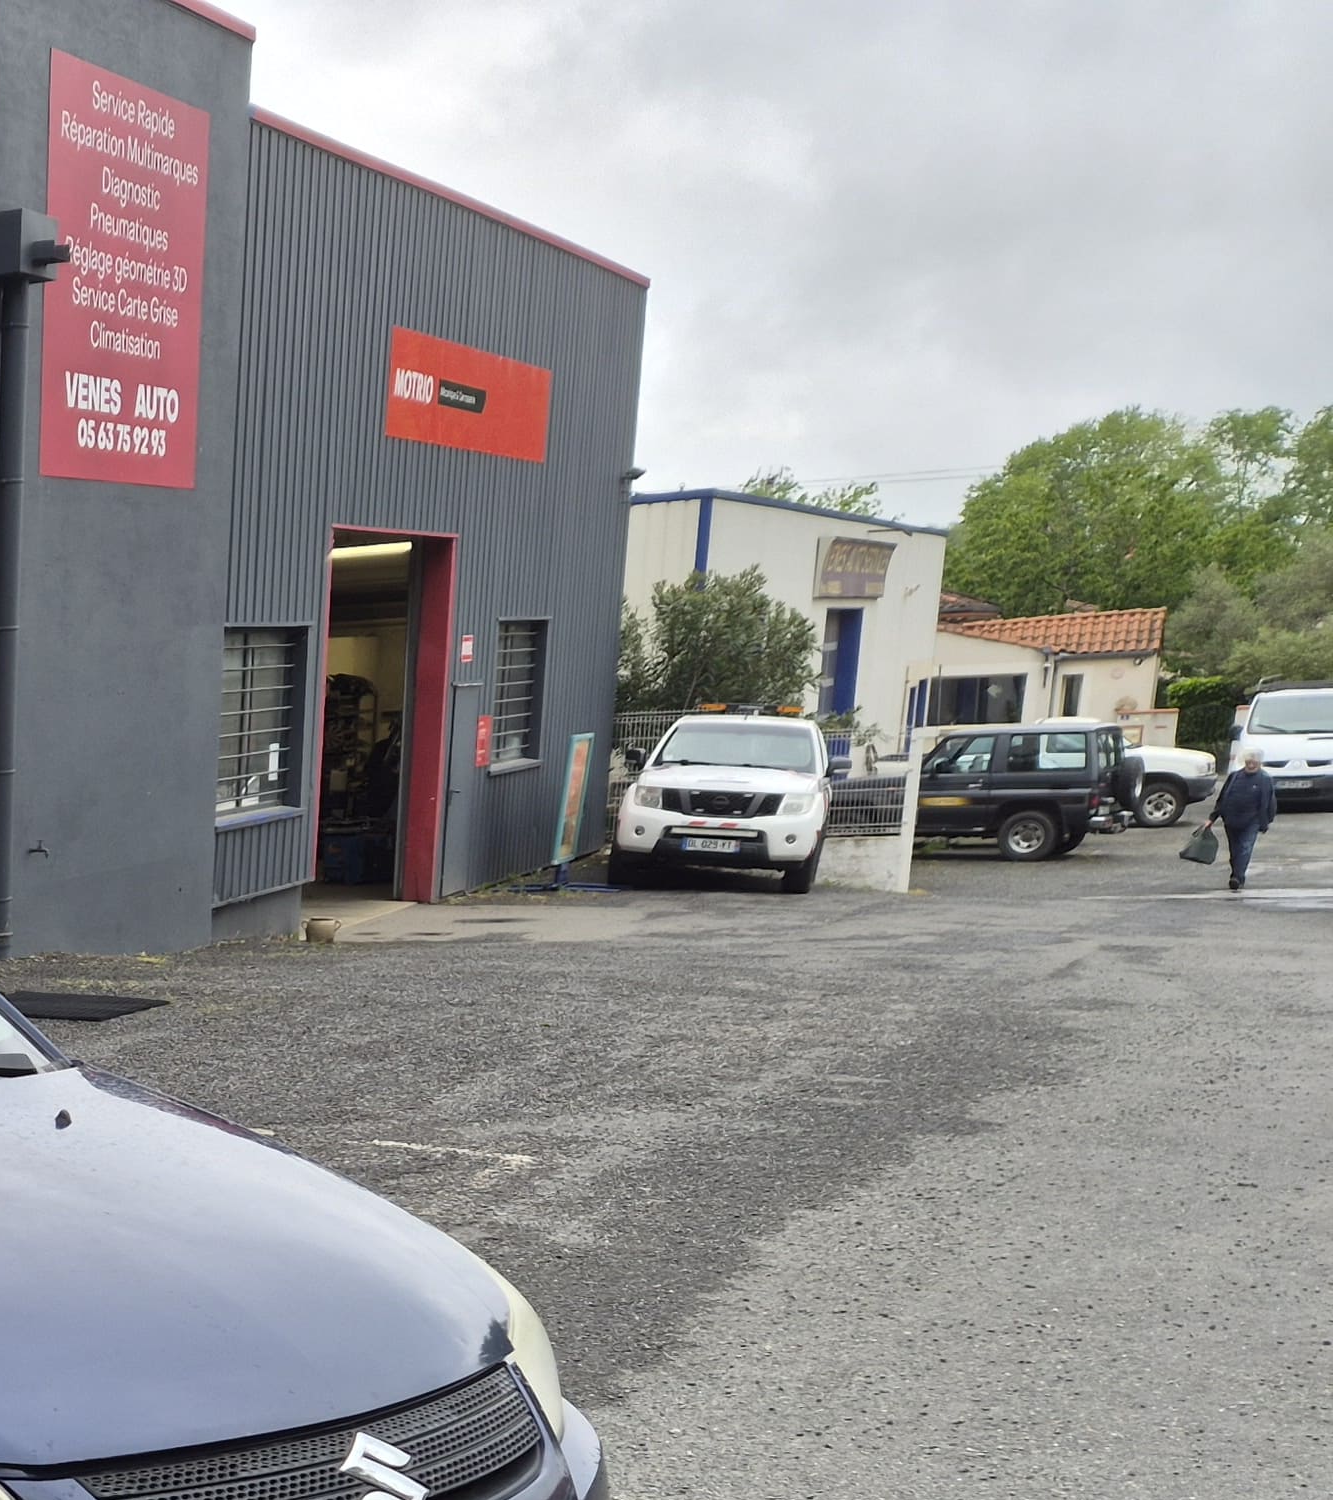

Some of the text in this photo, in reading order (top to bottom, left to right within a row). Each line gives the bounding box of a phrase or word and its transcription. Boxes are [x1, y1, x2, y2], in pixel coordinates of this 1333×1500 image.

[92, 80, 175, 139] Service Rapide
[61, 110, 199, 186] Réparation Multimarques
[102, 166, 161, 211] Diagnostic
[90, 203, 169, 252] Pneumatiques
[115, 252, 171, 289] géométrie
[173, 266, 188, 293] 3D
[72, 276, 178, 328] Service Carte Grise
[90, 320, 161, 360] Climatisation
[65, 371, 179, 423] VENES AUTO
[393, 367, 434, 405] MOTRIO
[77, 418, 166, 457] 05 63 75 92 93
